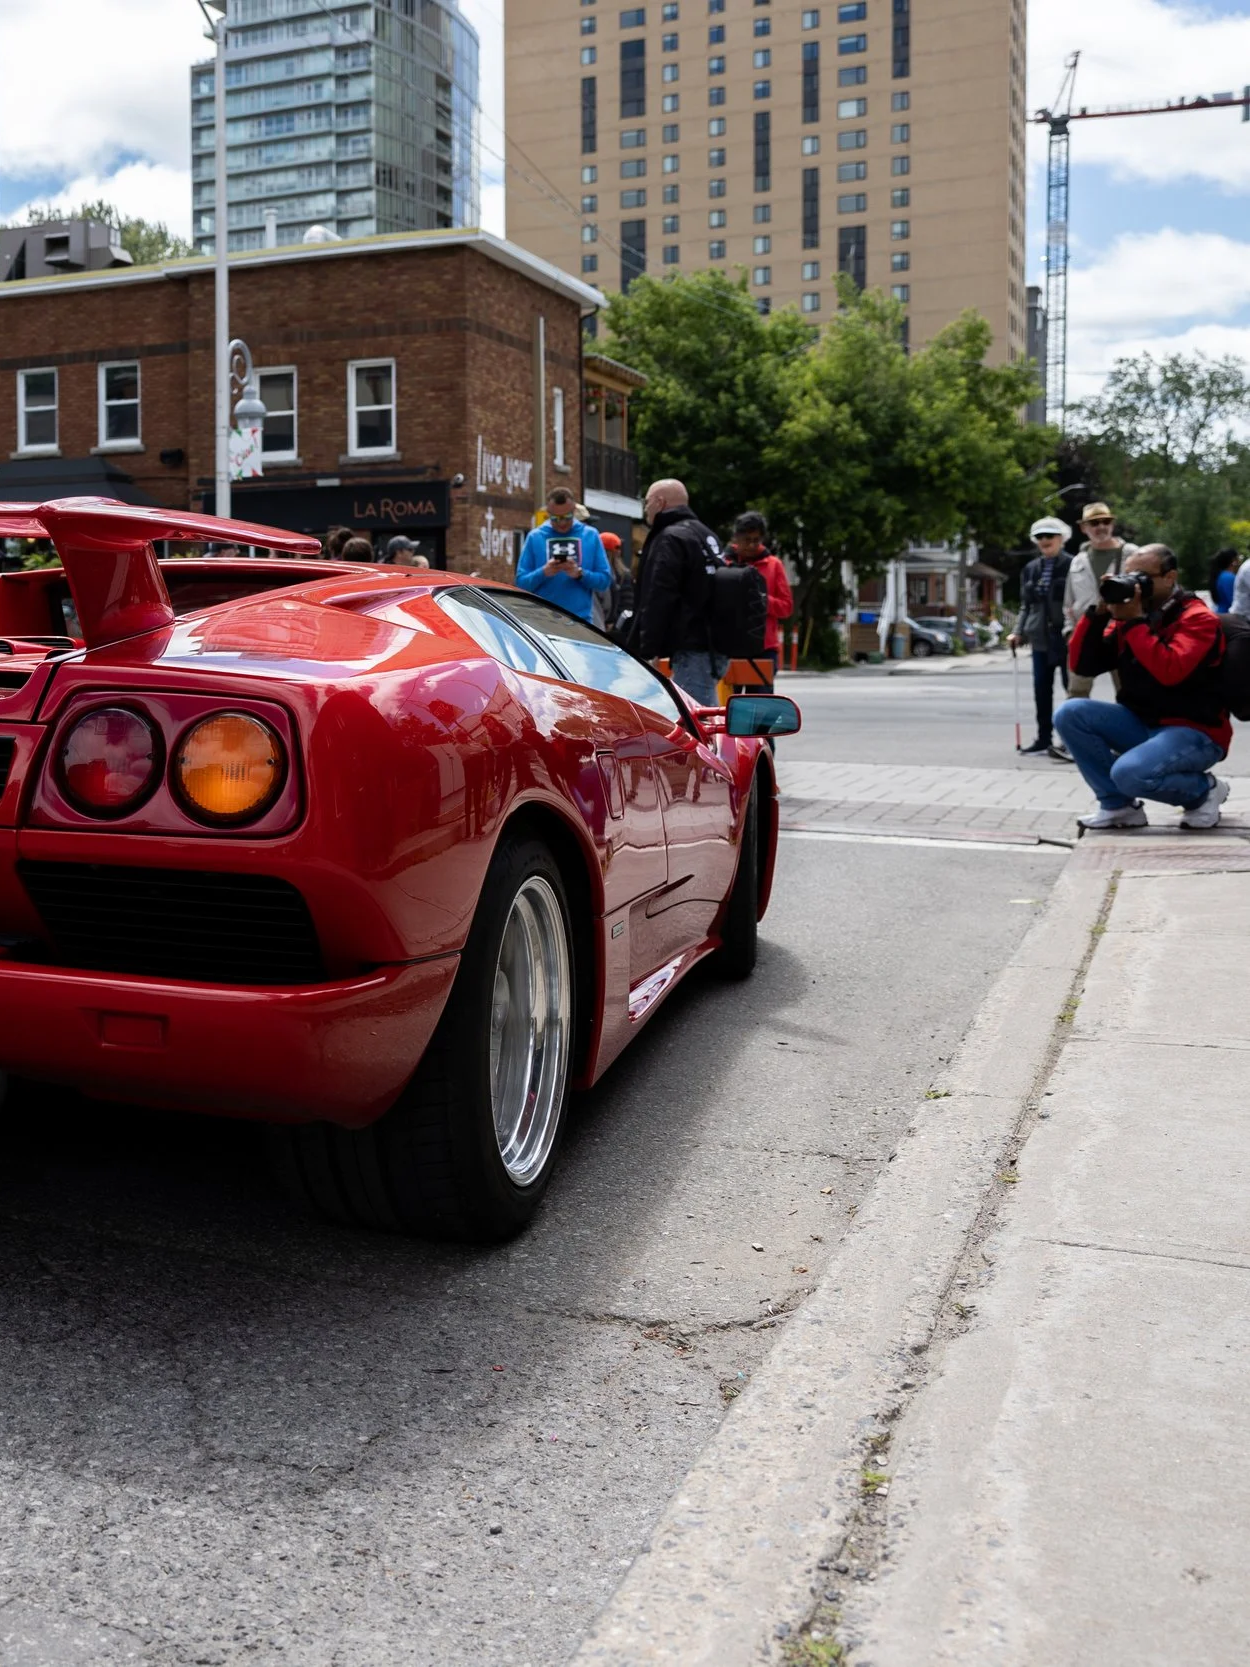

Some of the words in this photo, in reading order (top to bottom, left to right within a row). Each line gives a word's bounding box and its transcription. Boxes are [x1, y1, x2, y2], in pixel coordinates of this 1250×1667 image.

[476, 434, 503, 493] Live
[505, 455, 533, 495] your
[353, 500, 377, 519] LA
[381, 498, 437, 524] ROMA
[479, 506, 514, 566] story
